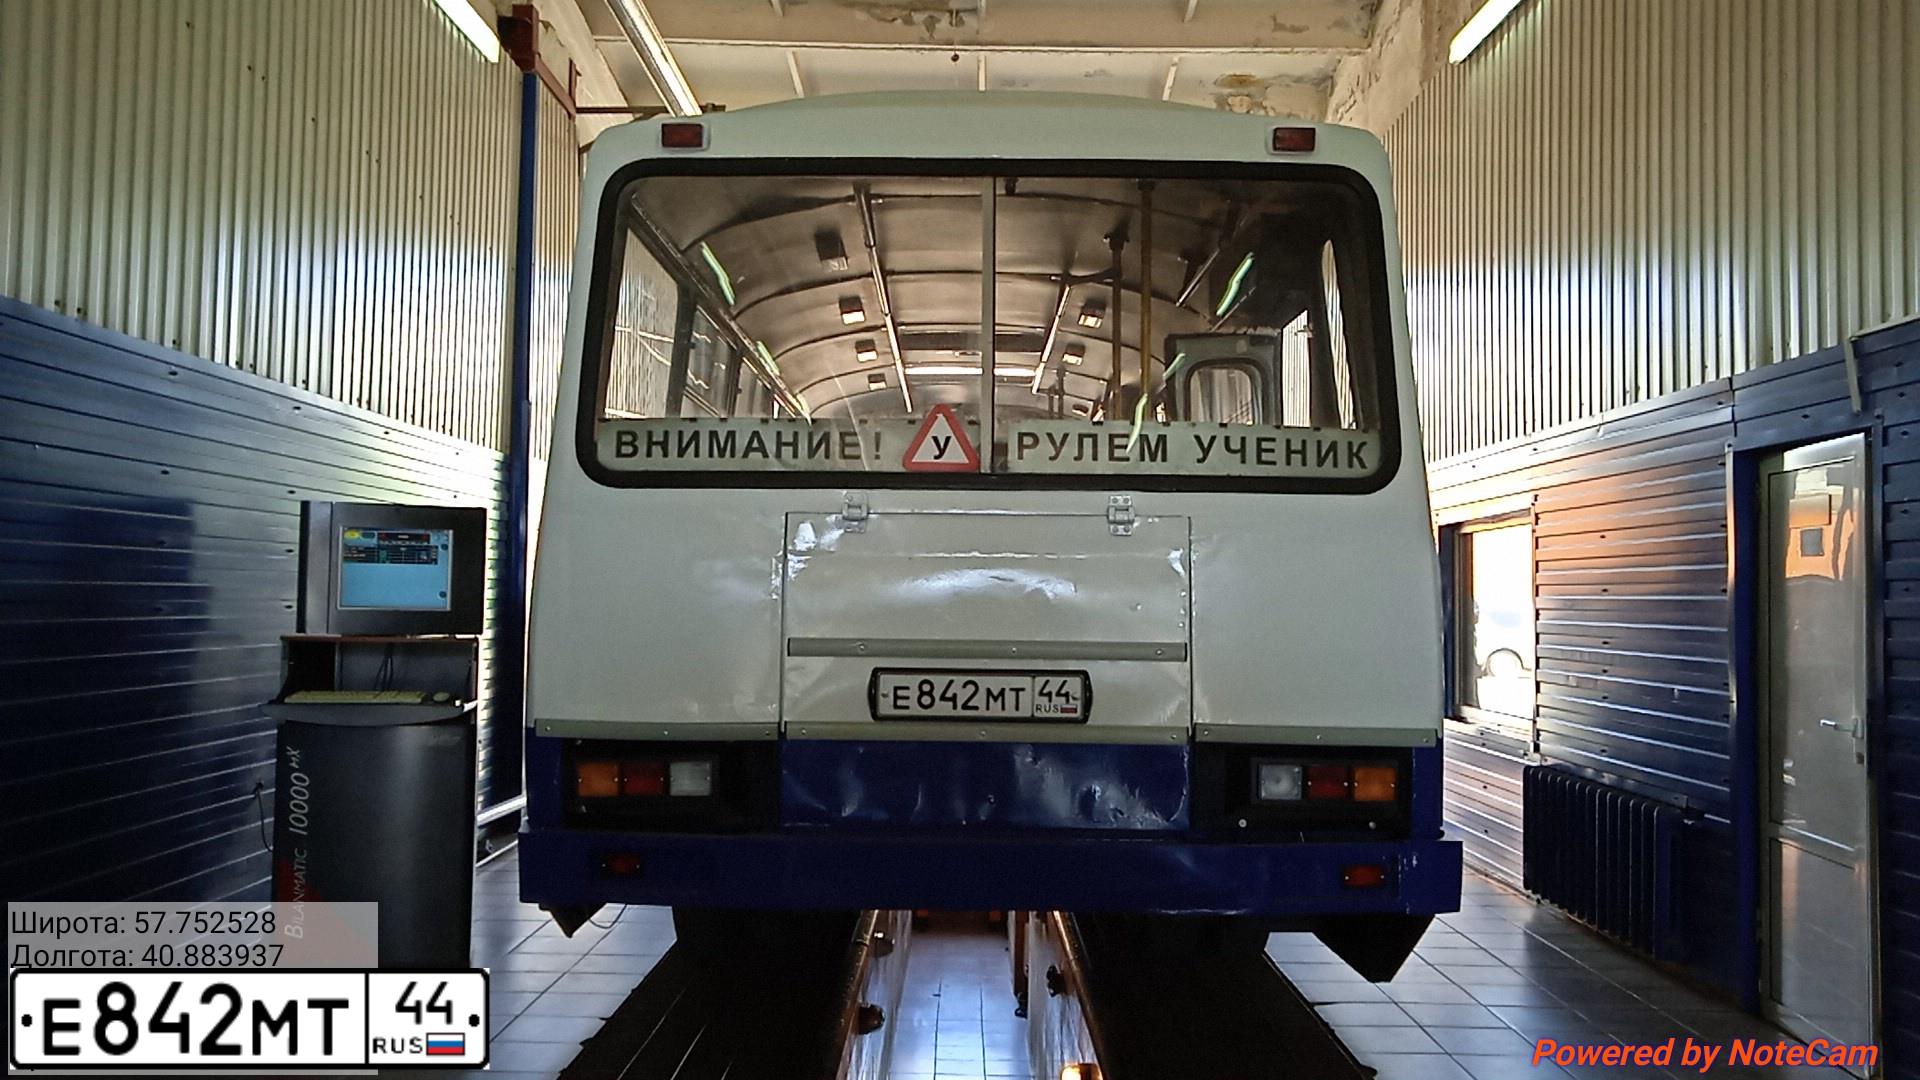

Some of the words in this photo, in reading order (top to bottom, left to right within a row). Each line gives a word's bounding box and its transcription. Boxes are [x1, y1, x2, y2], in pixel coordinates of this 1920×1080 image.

[615, 430, 881, 460] ВНИМАНИЕ!
[1017, 432, 1168, 462] РУЛЕМ
[1193, 435, 1369, 469] УЧЕНИК
[893, 679, 1026, 711] Е842МТ
[1038, 679, 1070, 704] 44
[1035, 703, 1059, 714] RUS
[288, 772, 310, 835] 10000
